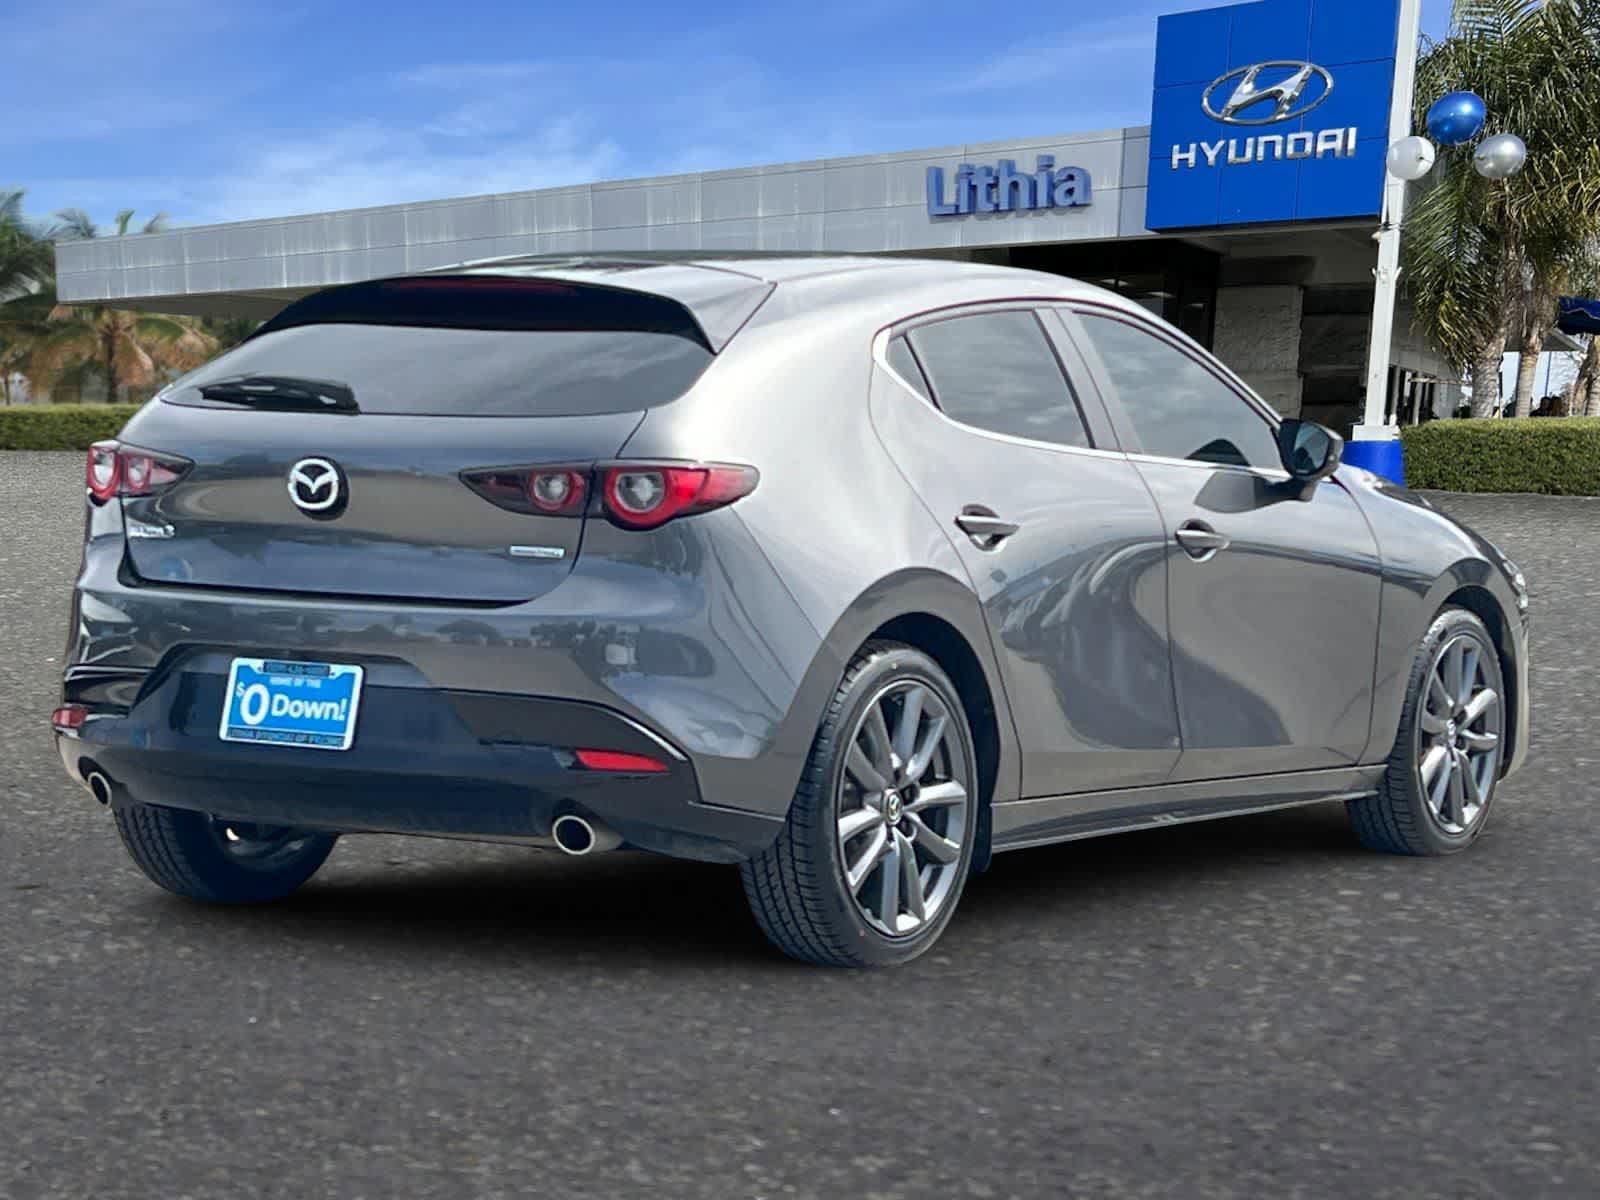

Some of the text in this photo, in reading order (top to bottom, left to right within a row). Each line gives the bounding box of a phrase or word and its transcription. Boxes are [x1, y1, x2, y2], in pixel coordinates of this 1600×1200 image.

[1170, 127, 1357, 169] HYUNDAI
[926, 155, 1092, 218] Lithia
[271, 693, 347, 721] Down!
